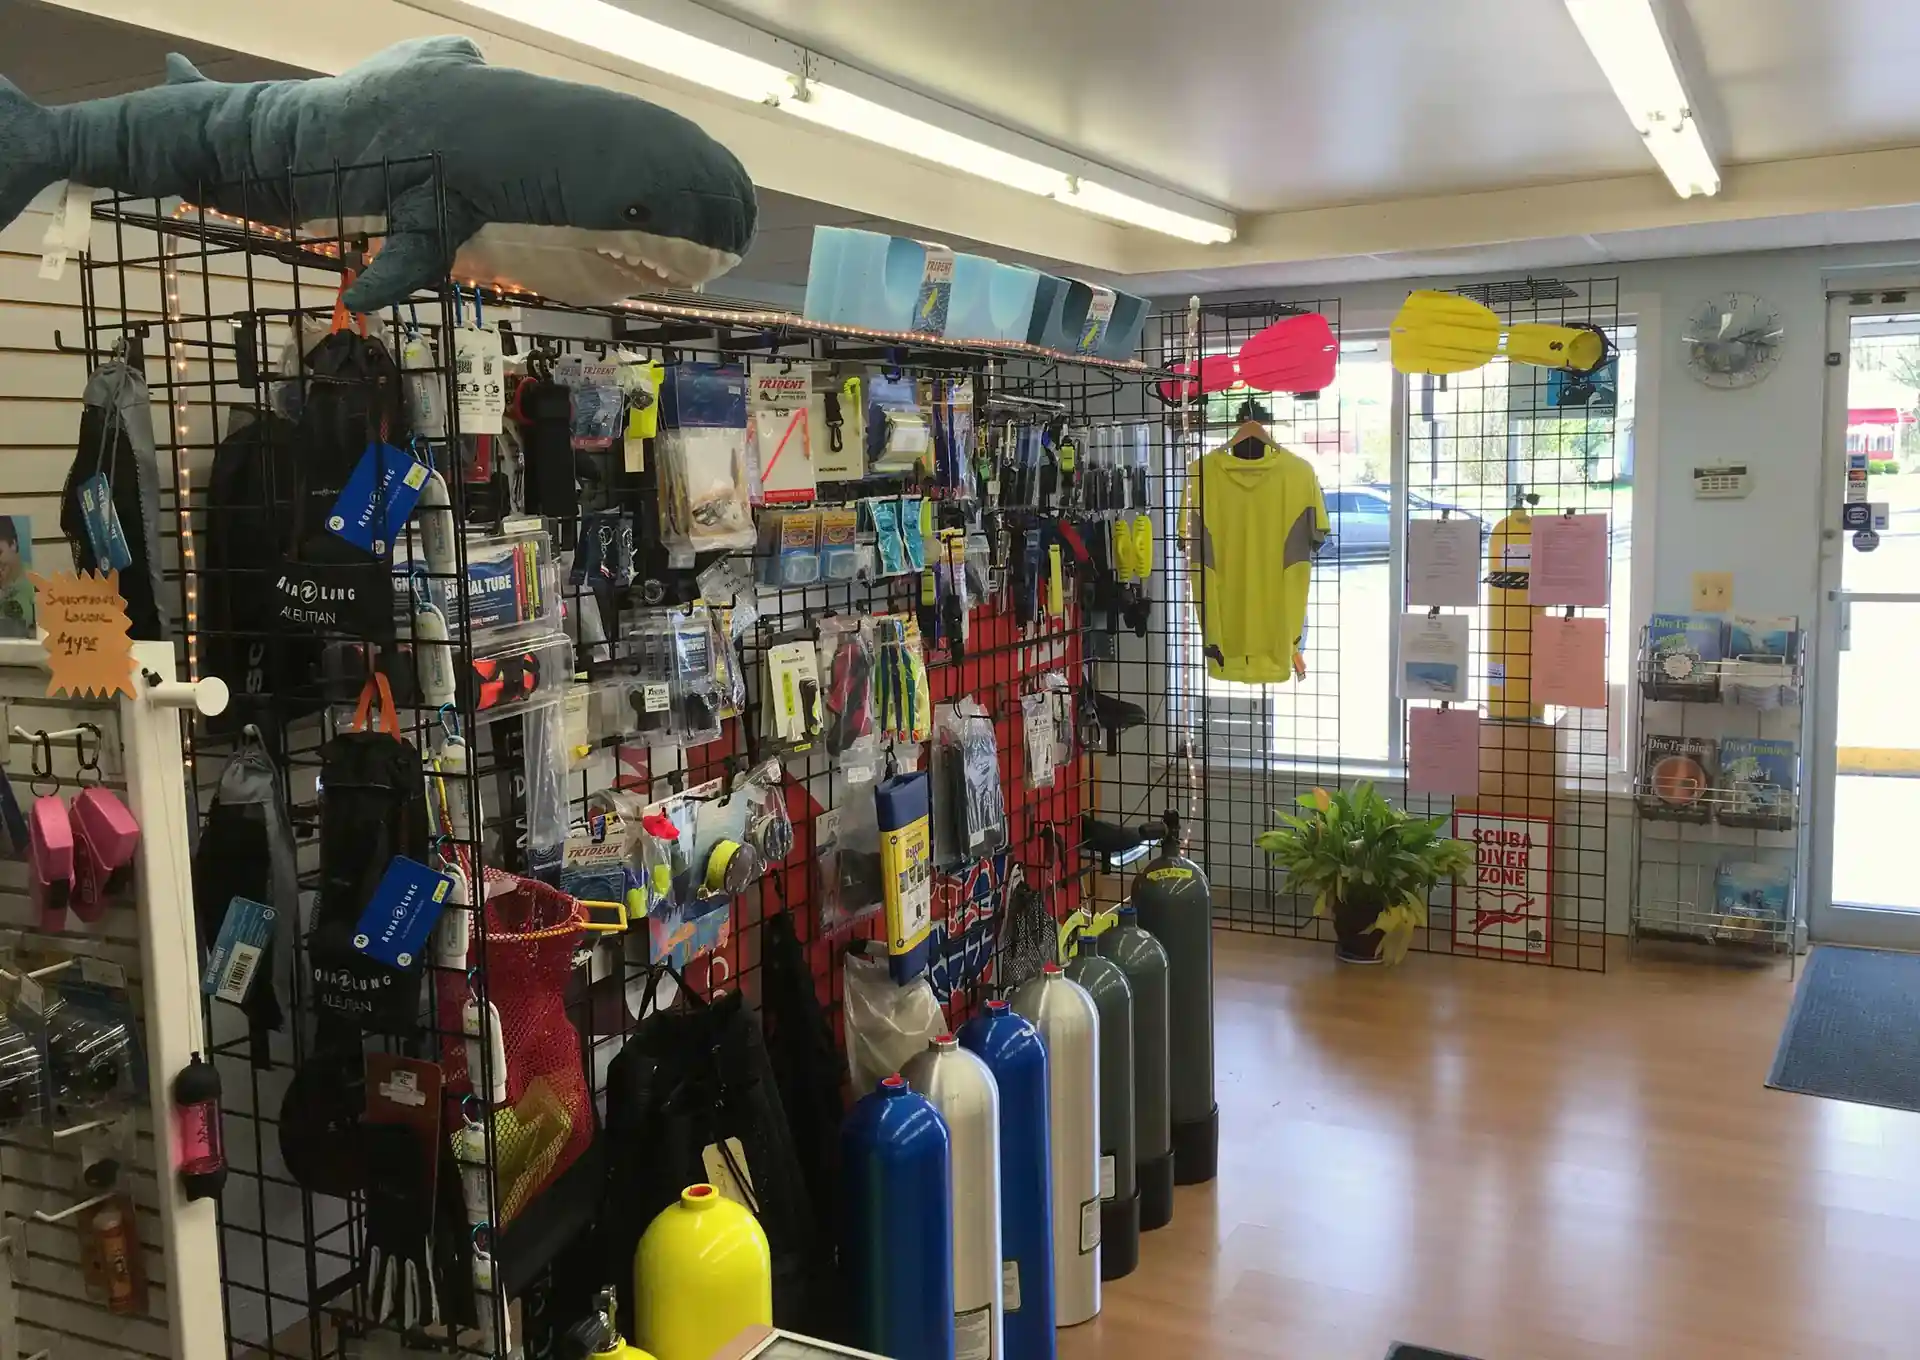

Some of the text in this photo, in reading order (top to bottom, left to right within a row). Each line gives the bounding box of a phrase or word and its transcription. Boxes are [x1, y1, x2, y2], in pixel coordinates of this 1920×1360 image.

[583, 366, 617, 375] TRIDENT
[758, 379, 806, 389] TRIDENT
[358, 502, 376, 528] AQUA
[321, 586, 356, 601] LUNG
[485, 574, 512, 594] TUBE
[279, 605, 337, 625] ALEUTIAN
[1472, 828, 1533, 850] SCUBA
[568, 843, 622, 859] TRIDENT
[1476, 848, 1528, 868] DIVER
[1478, 866, 1527, 886] ZONE
[381, 919, 400, 943] AQUA
[400, 883, 418, 907] LUNG
[352, 975, 392, 991] LUNG
